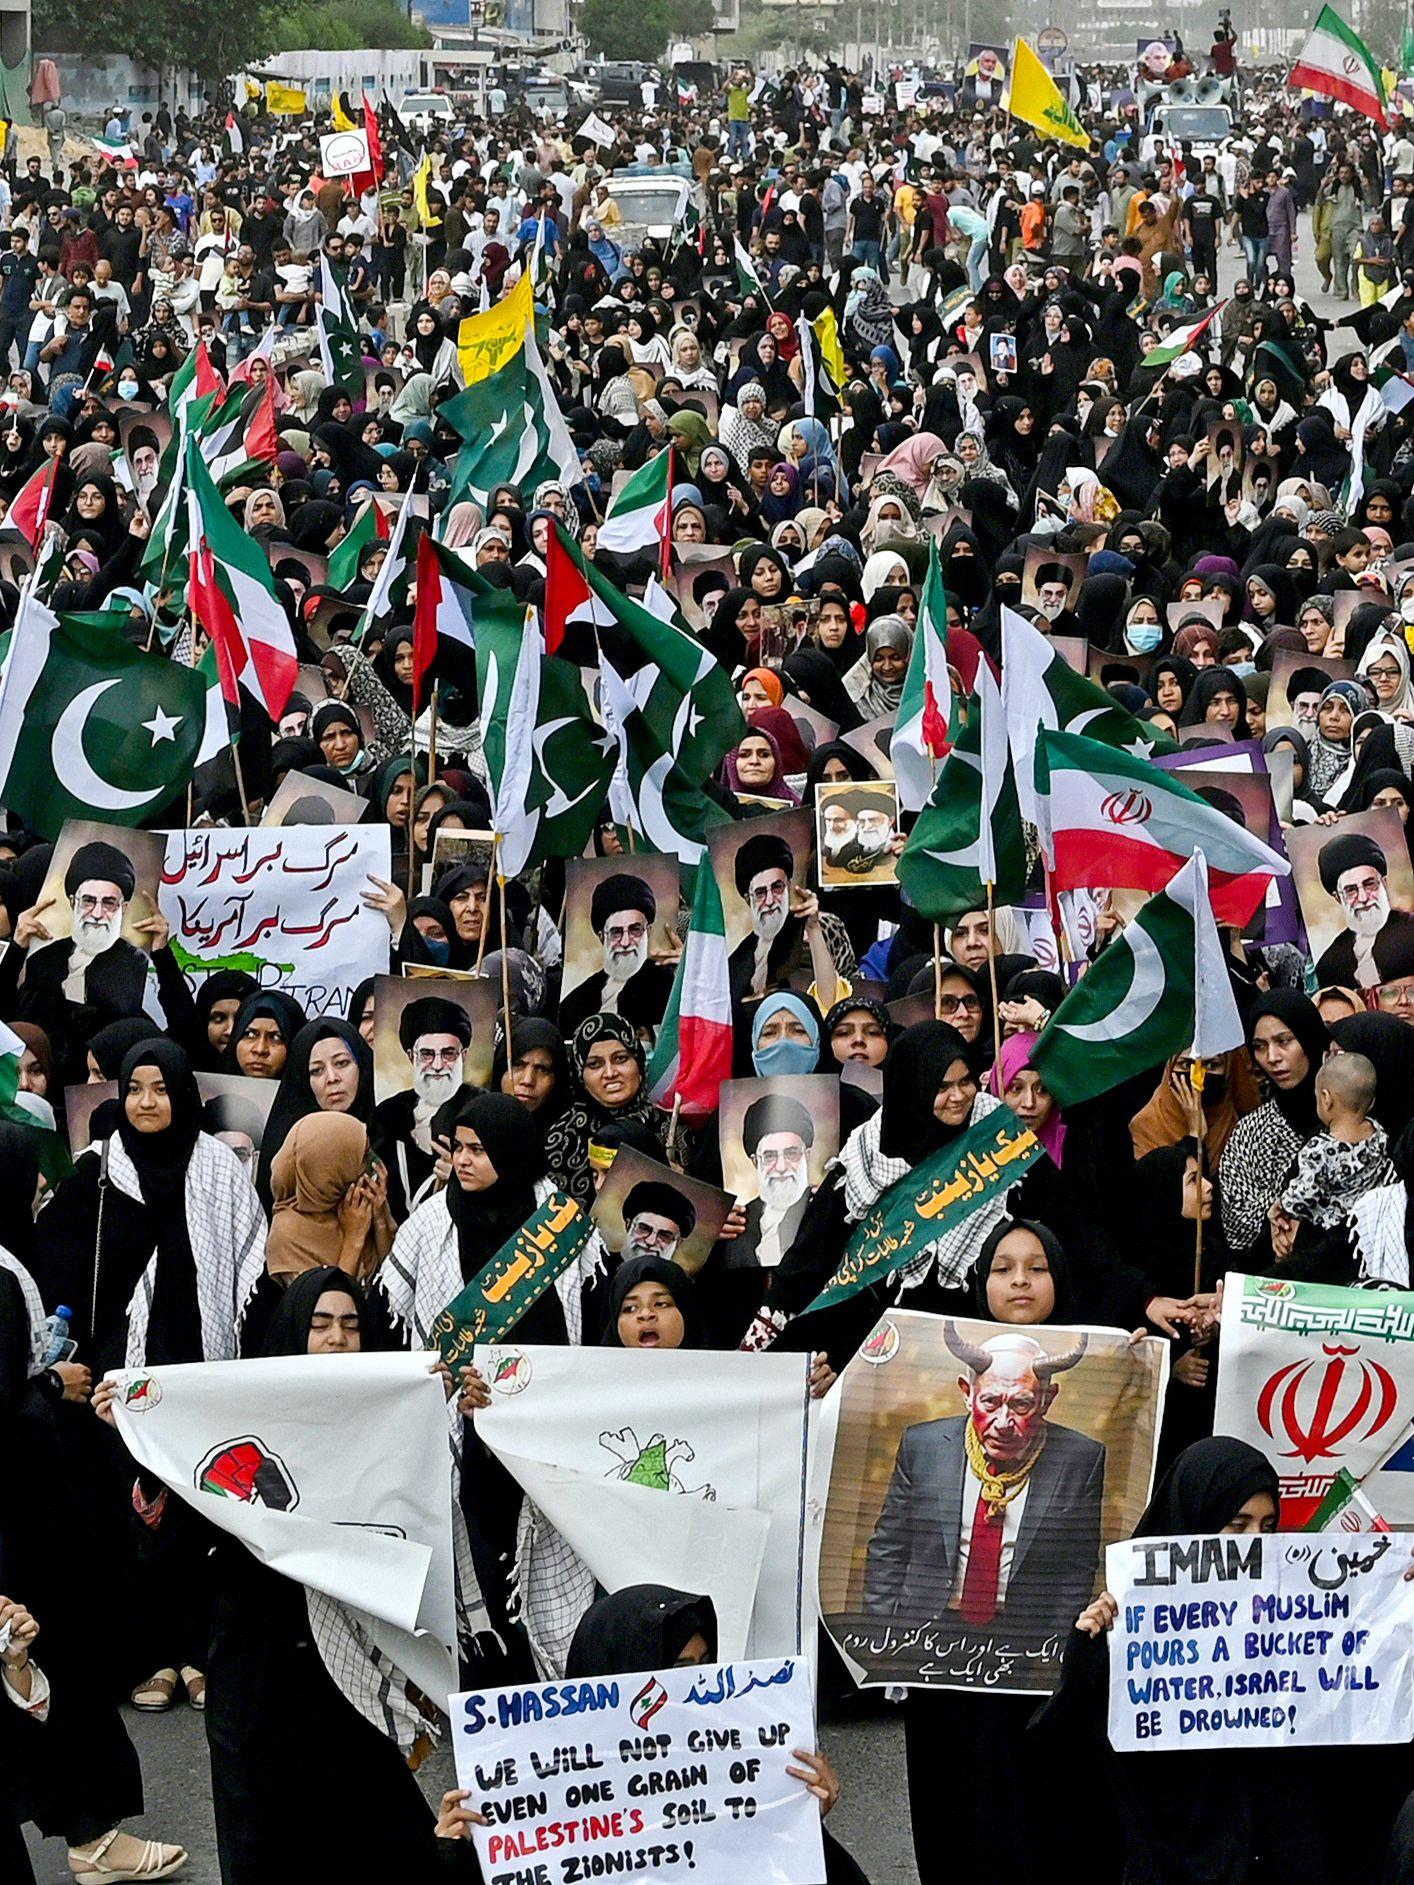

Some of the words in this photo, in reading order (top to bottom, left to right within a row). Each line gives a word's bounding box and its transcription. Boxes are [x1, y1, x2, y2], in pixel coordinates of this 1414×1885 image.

[161, 829, 249, 887] اسرائیل
[232, 841, 283, 884] بر
[283, 830, 359, 891] مرگ
[280, 897, 360, 950] مرگ
[1132, 1538, 1262, 1587] IMAM
[1125, 1604, 1145, 1634] IF
[1154, 1600, 1238, 1633] EVERY
[843, 1632, 870, 1650] روم
[936, 1636, 967, 1657] اس
[1127, 1638, 1199, 1671] POURS
[1211, 1636, 1230, 1662] A
[1244, 1630, 1333, 1660] BUCKET
[1341, 1629, 1370, 1656] OF
[918, 1659, 945, 1683] ہے
[463, 1680, 620, 1735] S.HASSAN
[1135, 1711, 1162, 1739] BE
[1179, 1705, 1297, 1735] DROWNED!
[475, 1758, 518, 1792] WE
[619, 1734, 672, 1764] NOT
[757, 1722, 791, 1748] UP
[481, 1793, 548, 1826] EVEN
[565, 1780, 615, 1809] ONE
[728, 1758, 762, 1784] OF
[725, 1796, 758, 1820] TO
